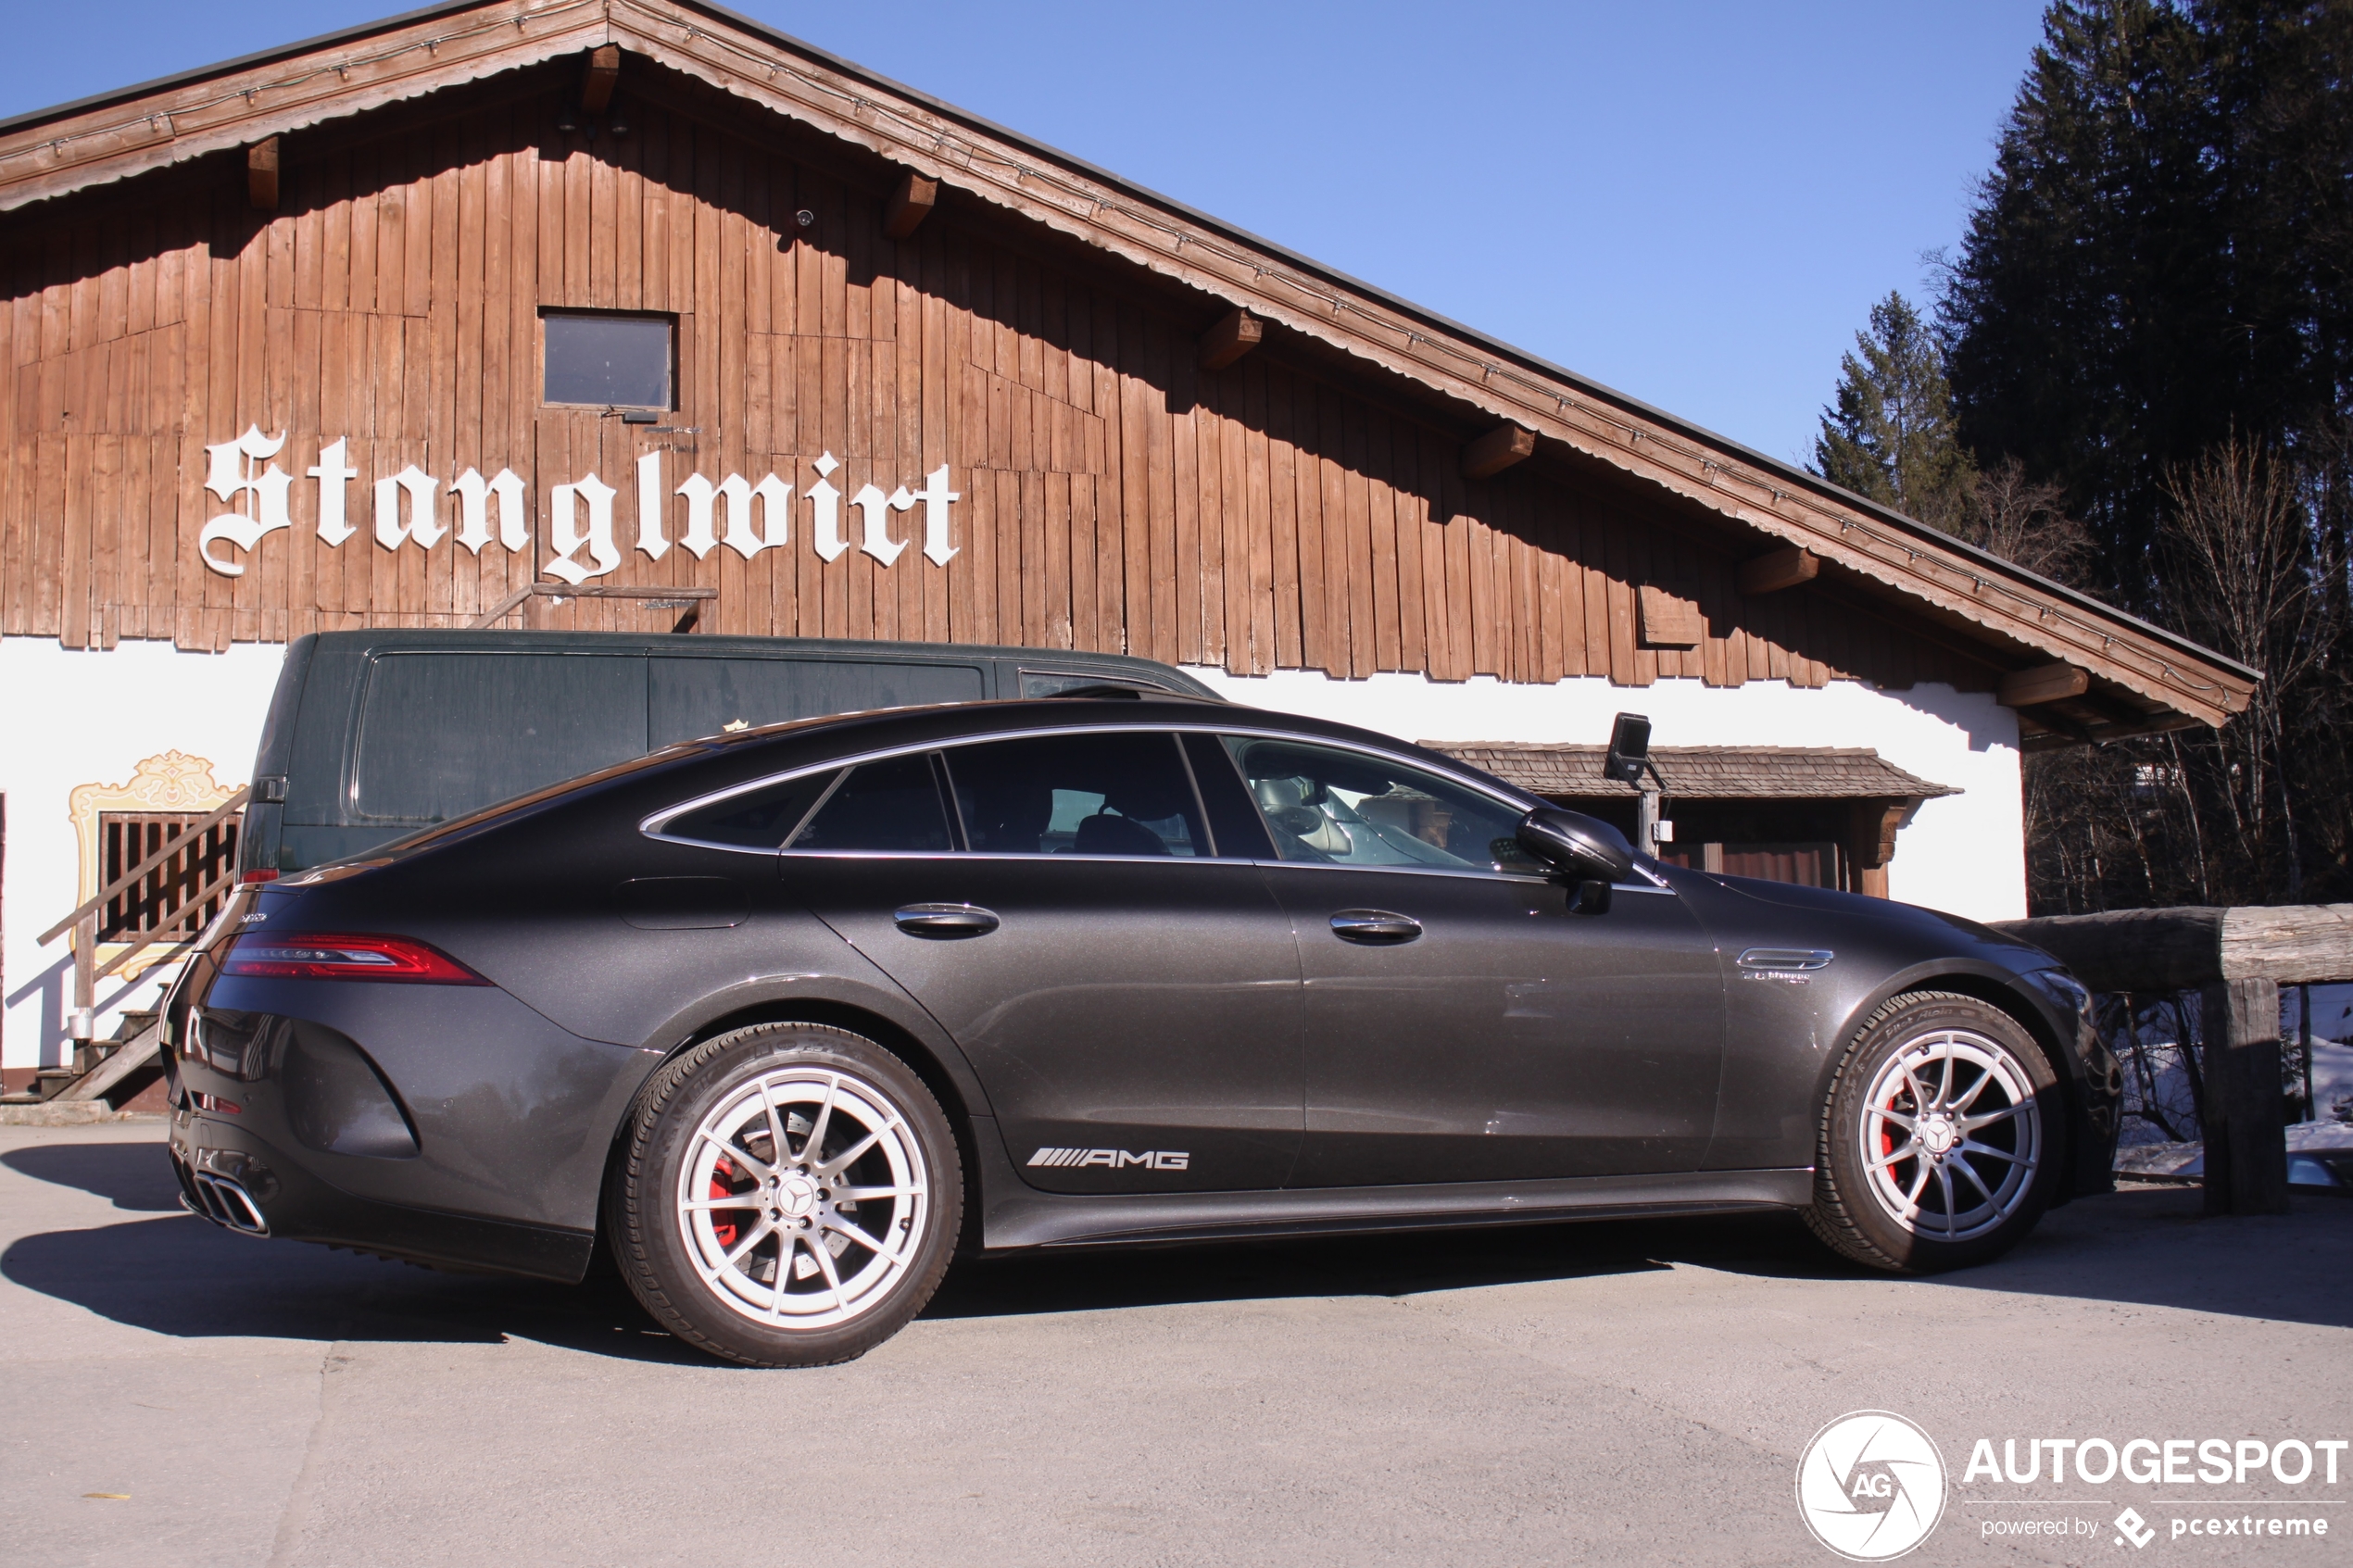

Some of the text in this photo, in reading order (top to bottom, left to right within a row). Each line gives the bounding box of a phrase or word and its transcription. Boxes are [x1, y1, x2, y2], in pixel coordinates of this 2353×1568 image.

[199, 422, 961, 585] Stanglwirt
[688, 1041, 772, 1100] MICIN
[1077, 1148, 1190, 1171] AMG
